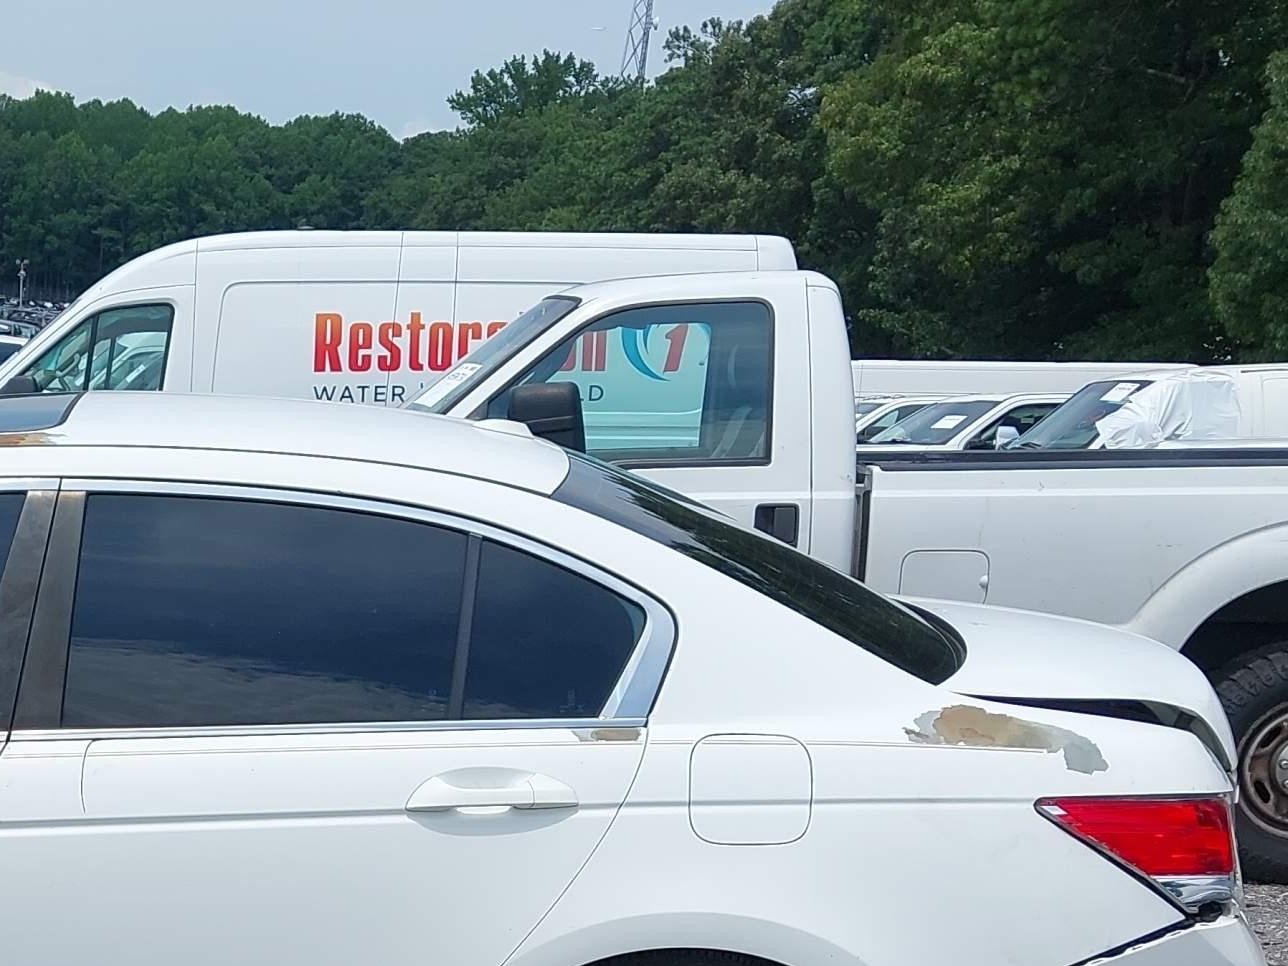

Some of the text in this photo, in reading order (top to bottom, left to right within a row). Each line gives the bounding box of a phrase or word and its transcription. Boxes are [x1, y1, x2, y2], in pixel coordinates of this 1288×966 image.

[314, 312, 688, 372] Restorn 1
[314, 385, 406, 403] WATER
